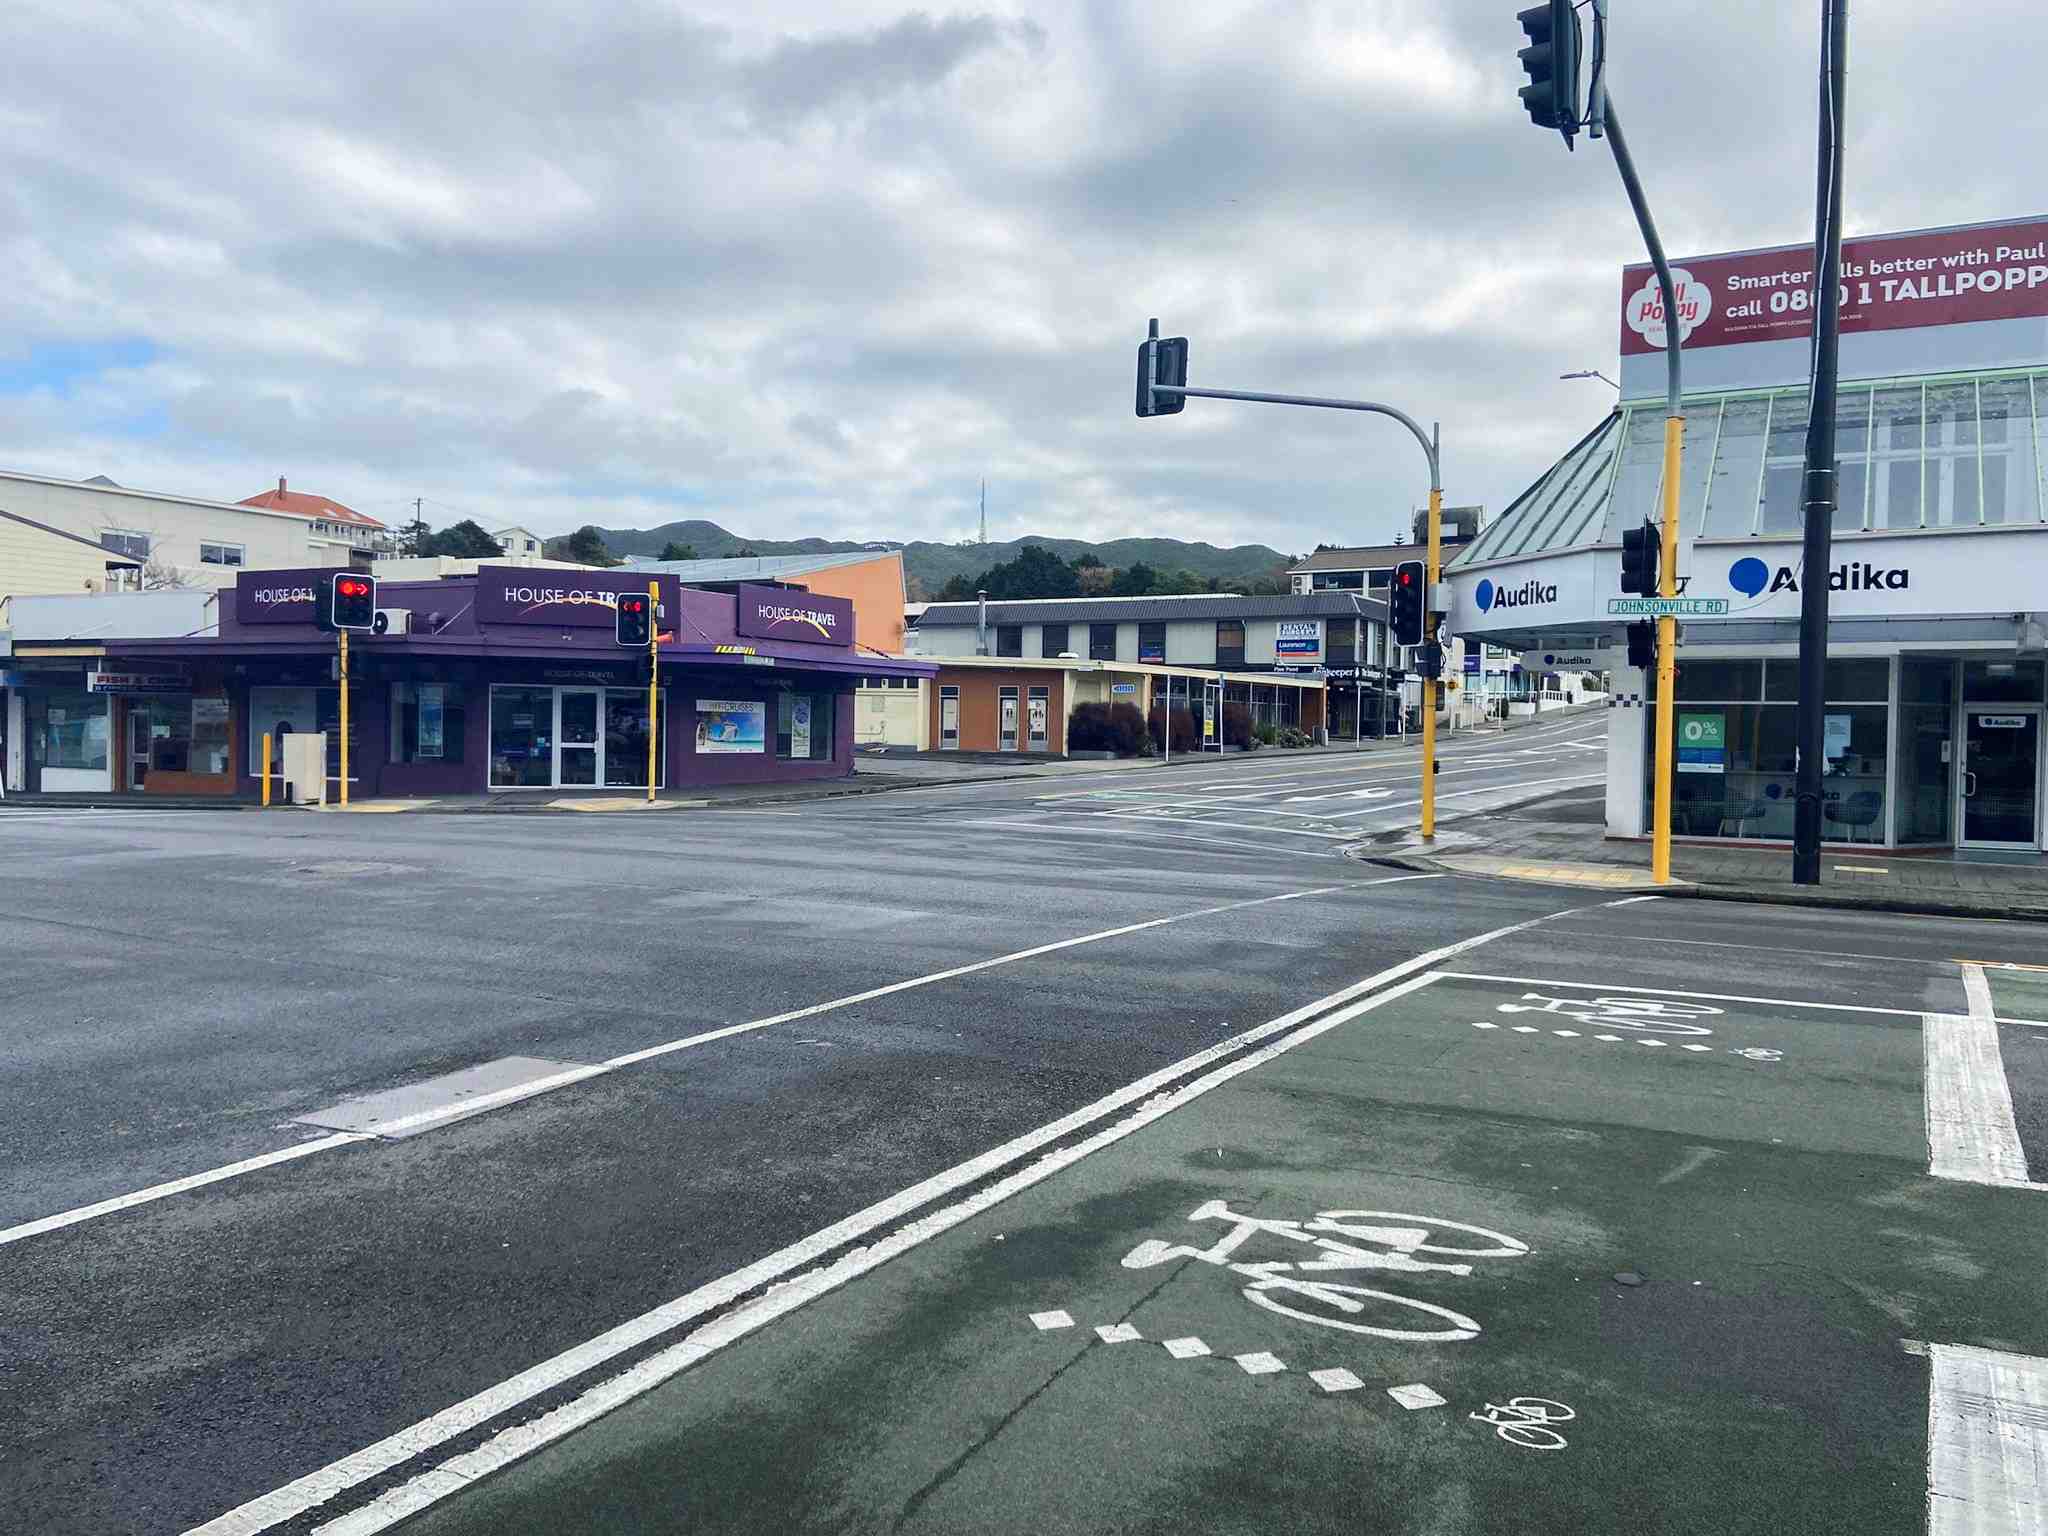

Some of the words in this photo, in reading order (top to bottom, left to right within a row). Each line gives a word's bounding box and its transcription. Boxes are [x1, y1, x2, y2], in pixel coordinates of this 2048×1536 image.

[1727, 271, 1812, 291] Smarter
[1869, 257, 1937, 276] better
[1942, 248, 1989, 268] with
[1995, 242, 2046, 262] Paul
[1726, 299, 1763, 318] call
[1858, 282, 1873, 305] 1
[1769, 562, 1909, 592] Adika
[255, 588, 289, 603] HOUSE
[291, 588, 306, 602] OF
[505, 587, 564, 603] HOUSE
[569, 590, 593, 605] OF
[1493, 580, 1557, 609] Audika
[758, 604, 791, 621] HOUSE
[792, 609, 806, 622] OF
[807, 610, 836, 626] TRAVEL
[1615, 601, 1701, 612] JOHNSONVILLE
[1706, 601, 1722, 612] RD
[1556, 655, 1592, 665] Audika
[1685, 721, 1718, 740] 0%
